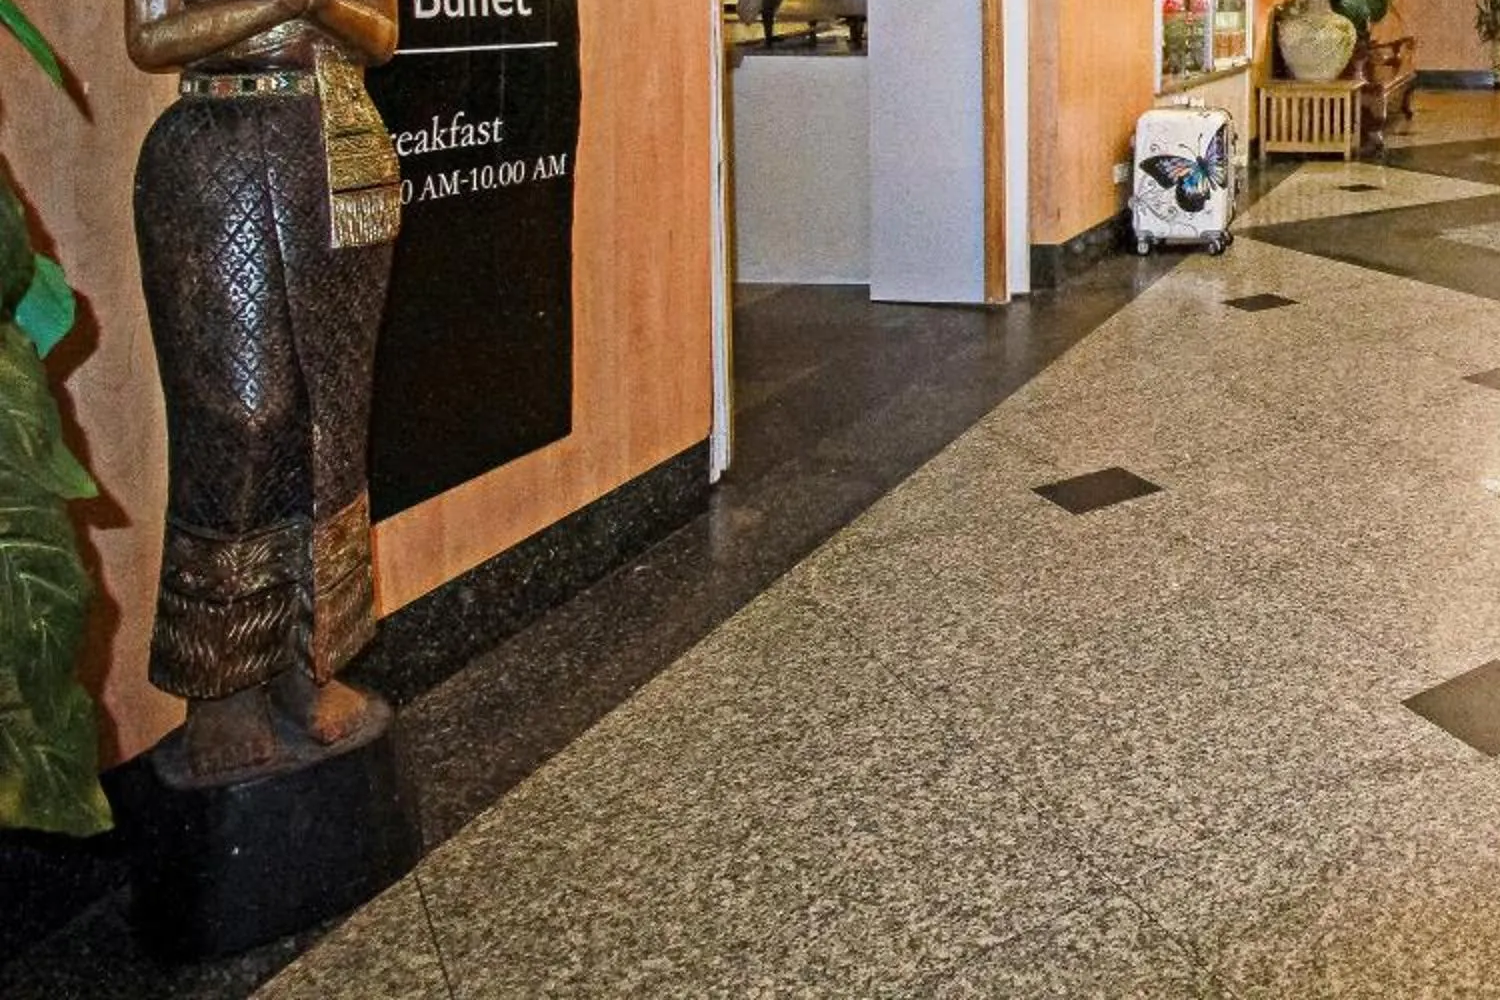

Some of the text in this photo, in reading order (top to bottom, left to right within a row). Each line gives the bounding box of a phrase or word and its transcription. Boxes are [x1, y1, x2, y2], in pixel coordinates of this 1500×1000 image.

[390, 111, 504, 157] eakfast
[418, 159, 526, 201] AM-10.00
[531, 153, 568, 181] AM
